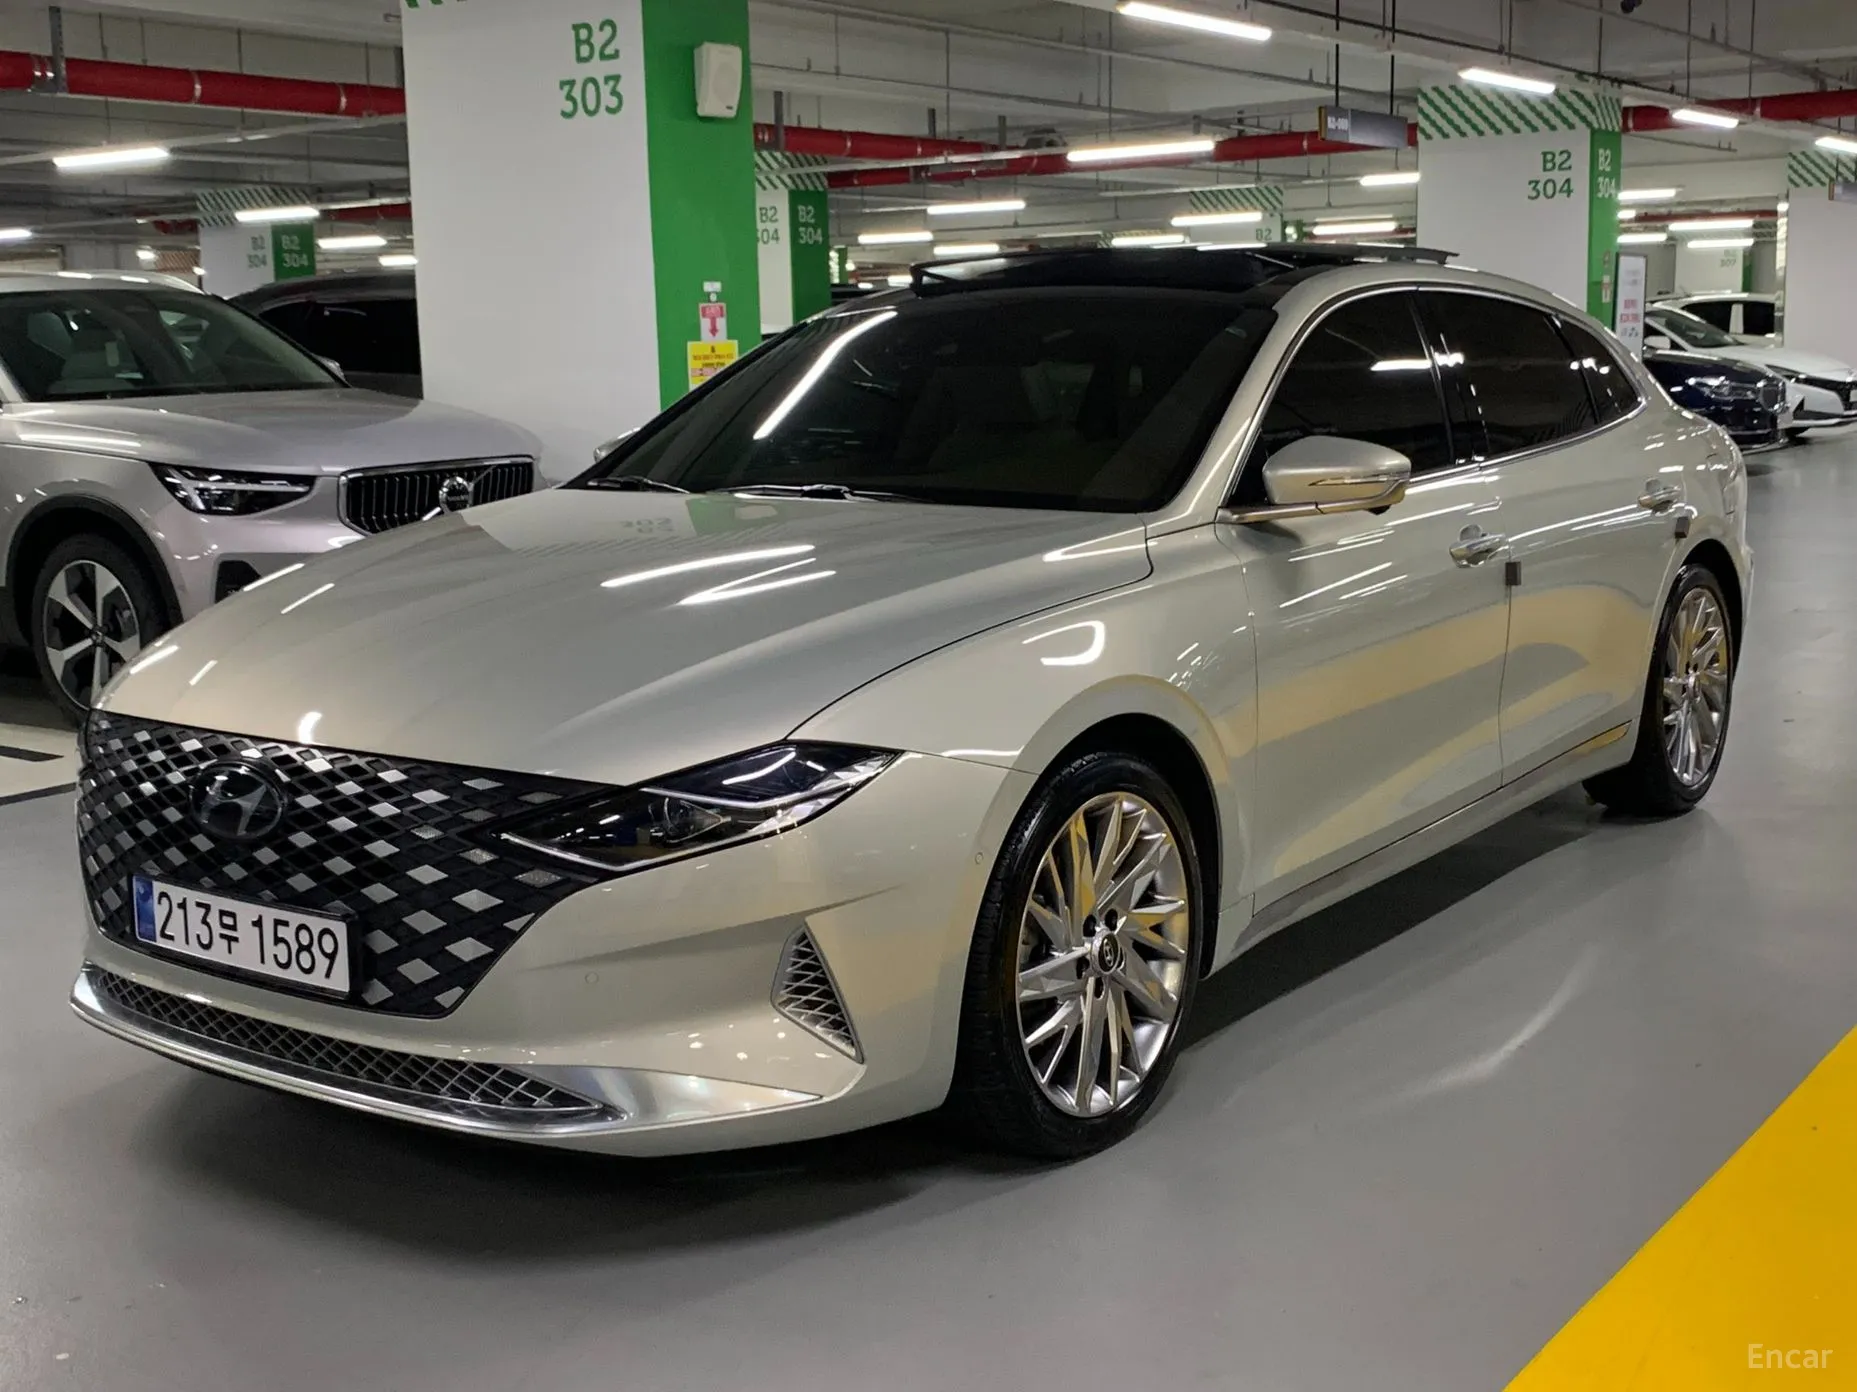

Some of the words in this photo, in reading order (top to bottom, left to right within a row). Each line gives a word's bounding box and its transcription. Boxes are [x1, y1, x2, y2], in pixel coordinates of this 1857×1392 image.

[572, 19, 619, 64] B2
[559, 73, 623, 119] 303
[1541, 150, 1572, 172] B2
[1598, 148, 1611, 171] B2
[1528, 178, 1573, 200] 304
[1597, 177, 1616, 198] 304
[759, 206, 778, 223] B2
[798, 205, 815, 223] B2
[281, 235, 300, 250] B2
[799, 227, 822, 245] 304
[282, 253, 308, 268] 304
[158, 891, 240, 954] 213무
[252, 914, 339, 979] 1589
